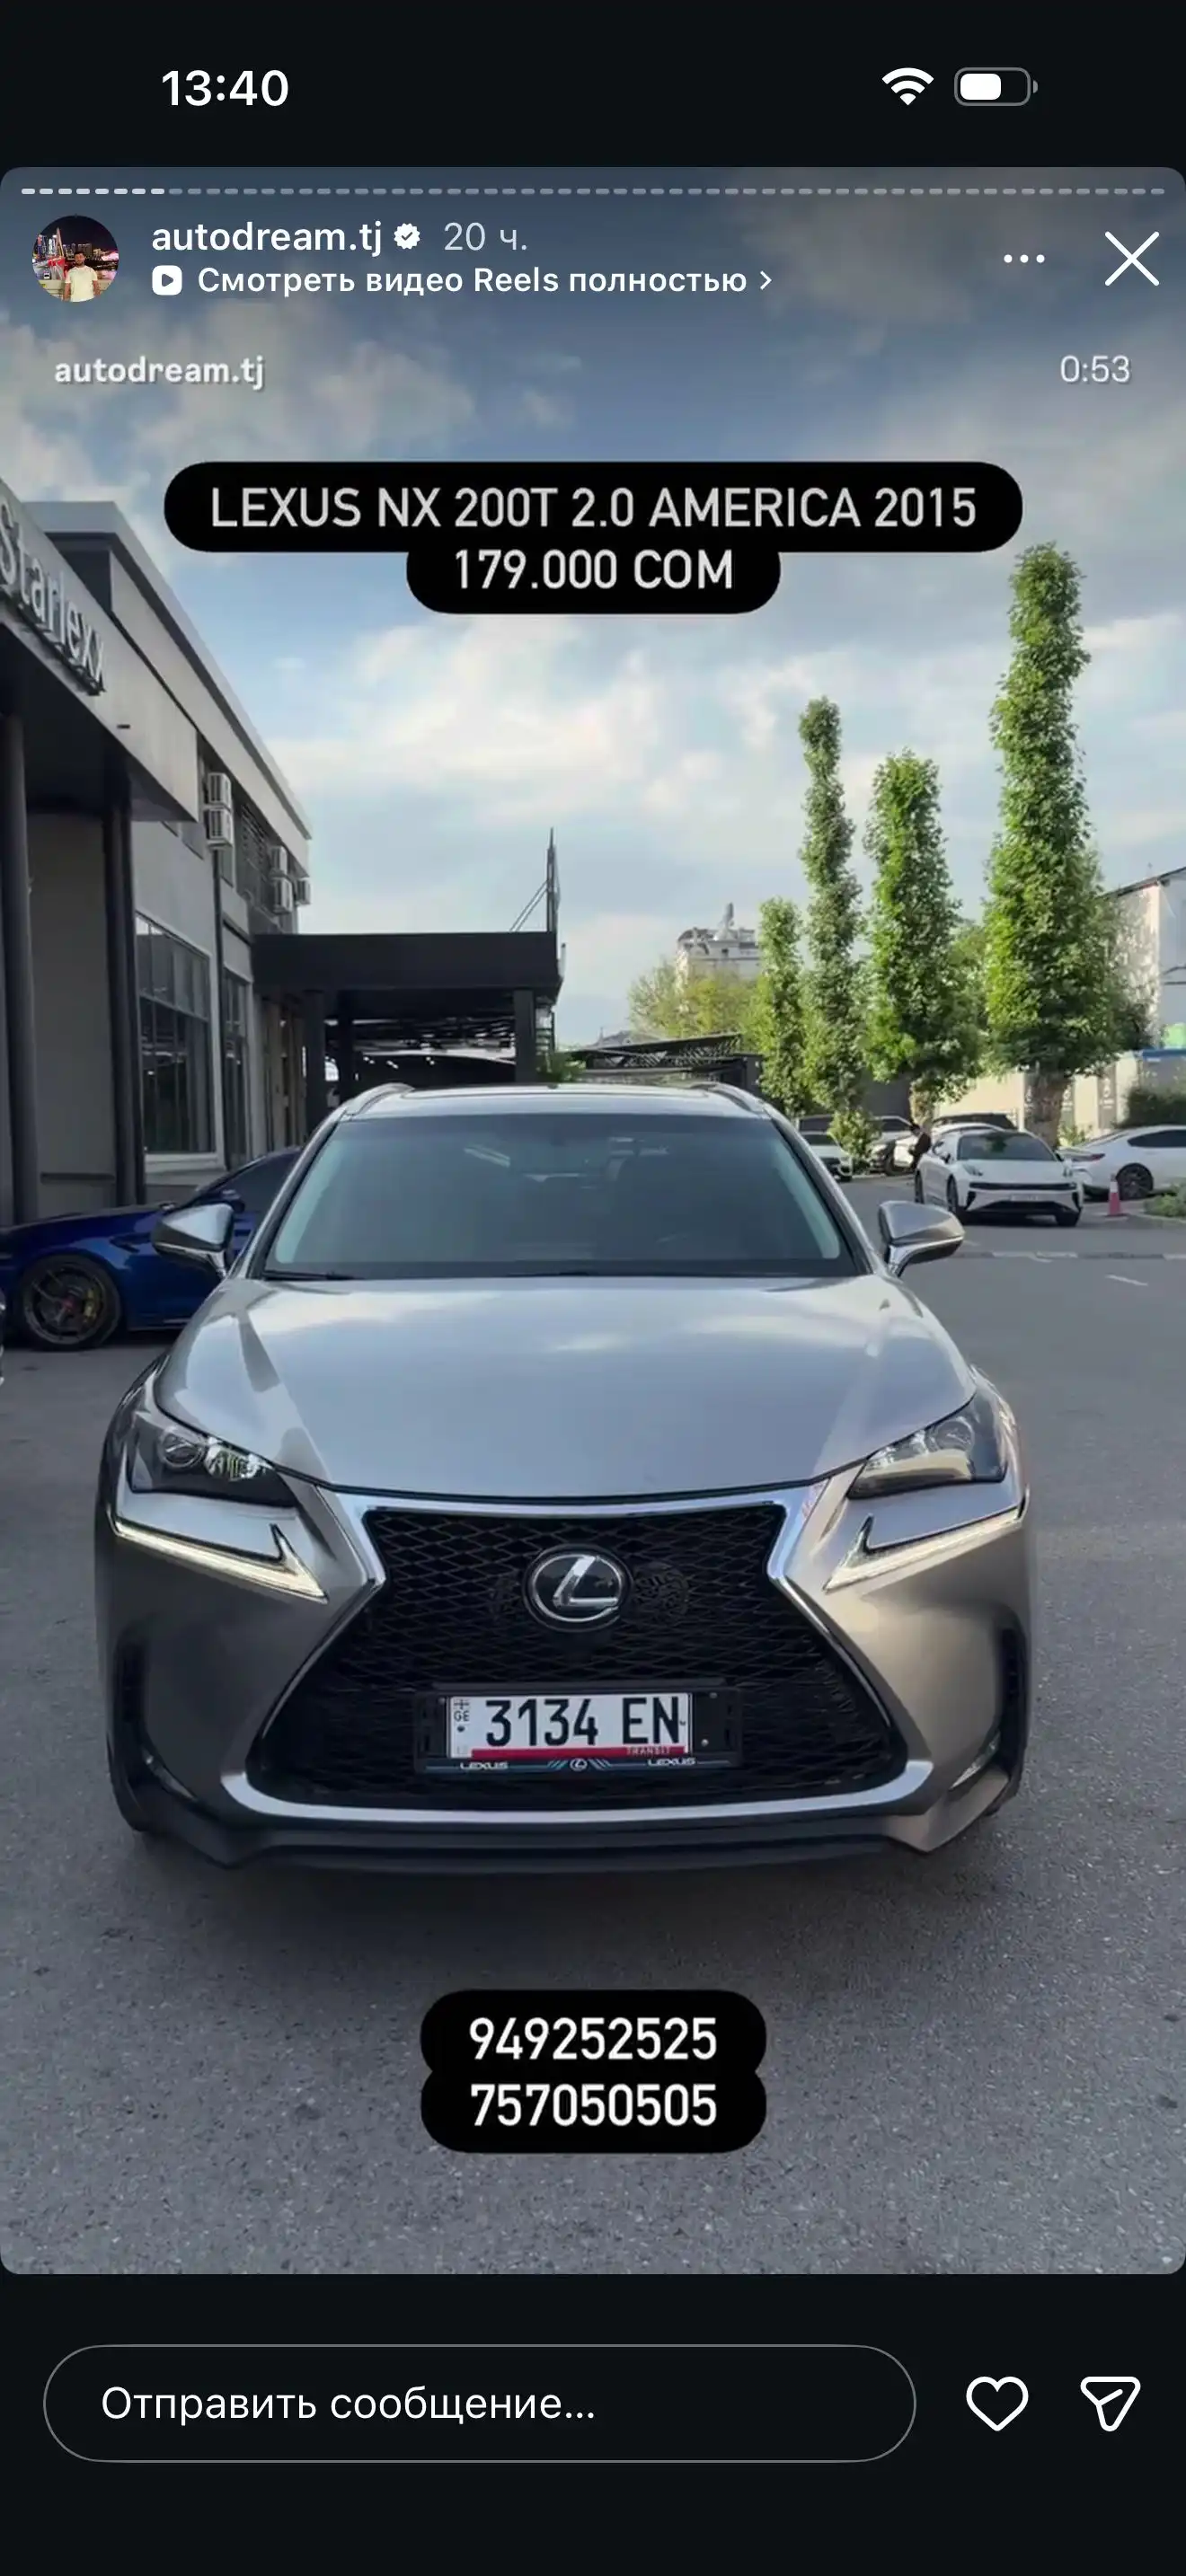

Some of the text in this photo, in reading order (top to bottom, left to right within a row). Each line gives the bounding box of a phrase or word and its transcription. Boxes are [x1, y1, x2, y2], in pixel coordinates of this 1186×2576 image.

[454, 1710, 470, 1723] GE
[485, 1696, 680, 1747] 3134 EN
[626, 1745, 671, 1756] TRANSIT
[459, 1761, 509, 1771] LEXUS
[647, 1757, 697, 1768] LEXUS
